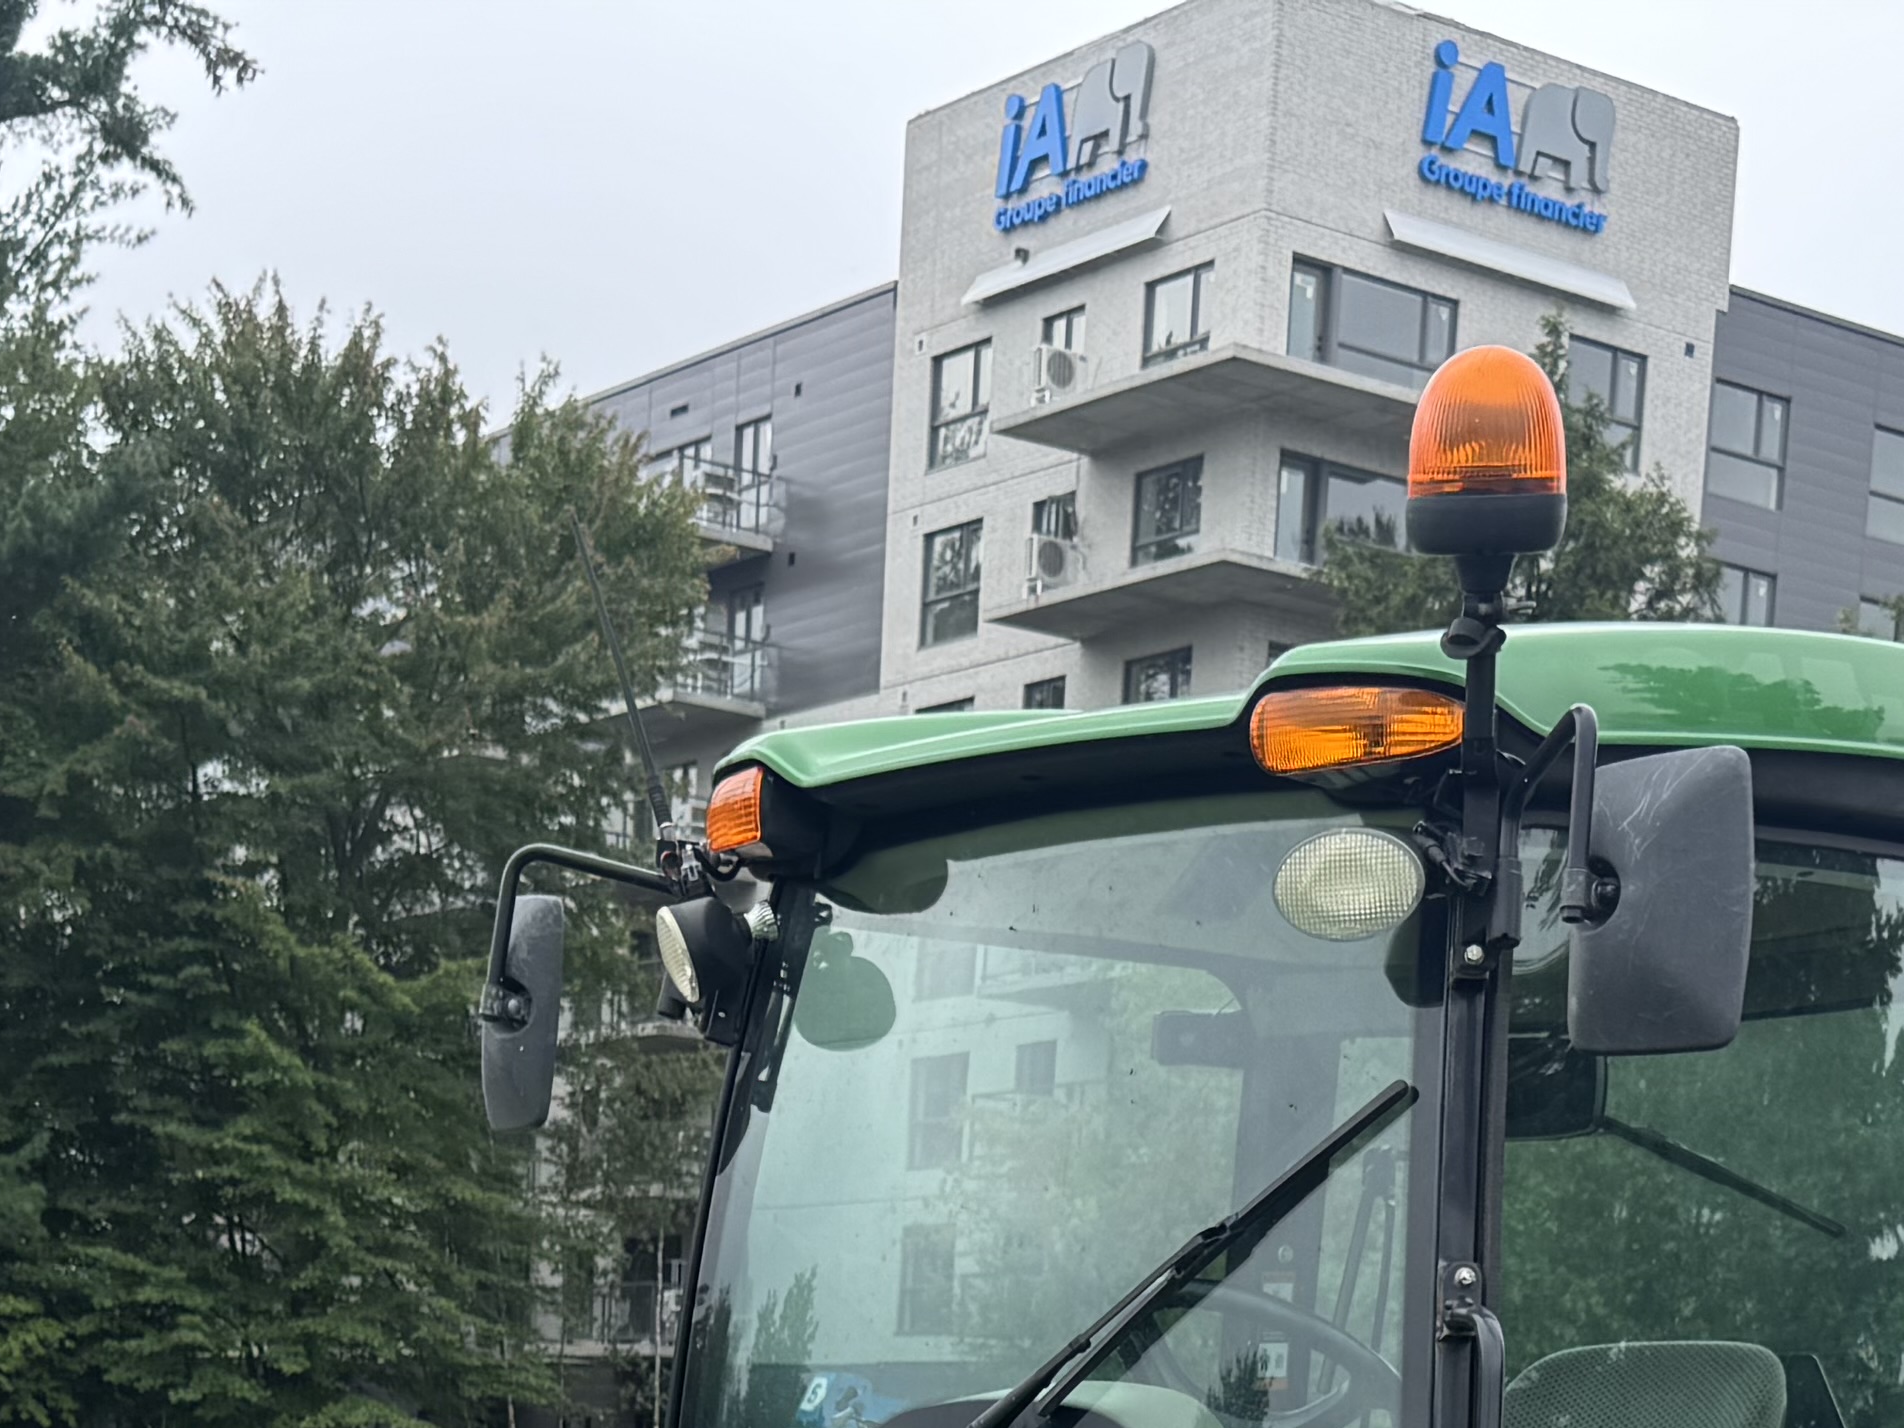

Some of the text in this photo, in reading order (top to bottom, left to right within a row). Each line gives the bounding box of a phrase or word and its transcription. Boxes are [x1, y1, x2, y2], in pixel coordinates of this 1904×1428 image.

[993, 158, 1148, 232] Groupe financier
[1418, 155, 1608, 235] Groupe financier
